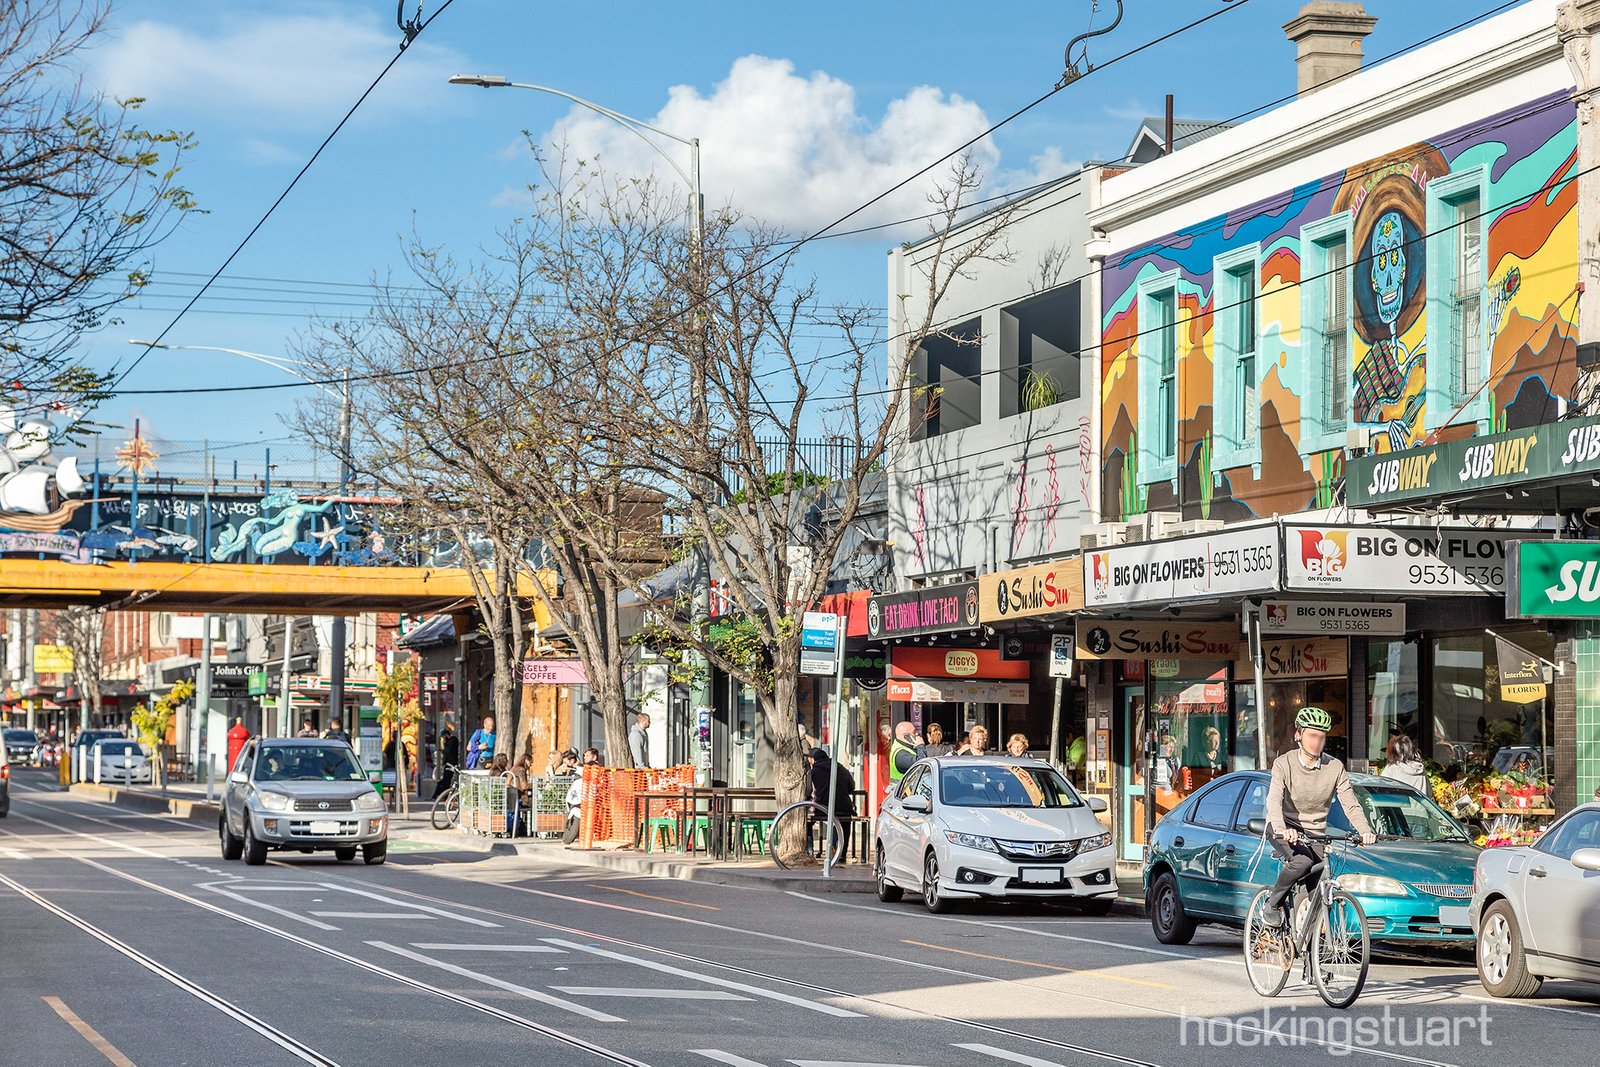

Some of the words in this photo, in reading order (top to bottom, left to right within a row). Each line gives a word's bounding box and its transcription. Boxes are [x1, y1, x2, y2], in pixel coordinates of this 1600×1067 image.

[1561, 424, 1600, 468] SUB
[1458, 433, 1537, 483] SUBWAY
[1368, 450, 1437, 497] SUBWAY
[1357, 537, 1397, 556] BIG
[1405, 538, 1439, 557] ON
[1448, 539, 1505, 559] FLO
[1114, 566, 1131, 586] BIG
[1132, 563, 1148, 585] ON
[1150, 556, 1205, 583] FLOWERS
[1213, 550, 1241, 577] 9531
[1243, 545, 1273, 573] 5365
[1306, 558, 1343, 576] BIG
[1409, 564, 1456, 585] 9531
[1464, 565, 1504, 586] 536
[884, 605, 898, 631] EAT
[898, 602, 919, 629] DRINK
[920, 599, 938, 627] LOVE
[939, 596, 959, 624] TACO
[1297, 607, 1316, 616] BIG
[1318, 608, 1336, 617] ON
[1338, 608, 1393, 618] FLOWERS
[1320, 620, 1344, 629] 9531
[1345, 620, 1370, 630] 5365
[1054, 636, 1071, 647] 2P
[1113, 628, 1181, 654] Sushi
[1181, 630, 1233, 654] San
[948, 656, 976, 667] ZIGGY'S
[1267, 645, 1301, 675] Sushi
[214, 666, 243, 676] John's
[1504, 671, 1533, 679] Interflora
[890, 685, 911, 695] STACKS
[1507, 686, 1541, 694] FLORIST
